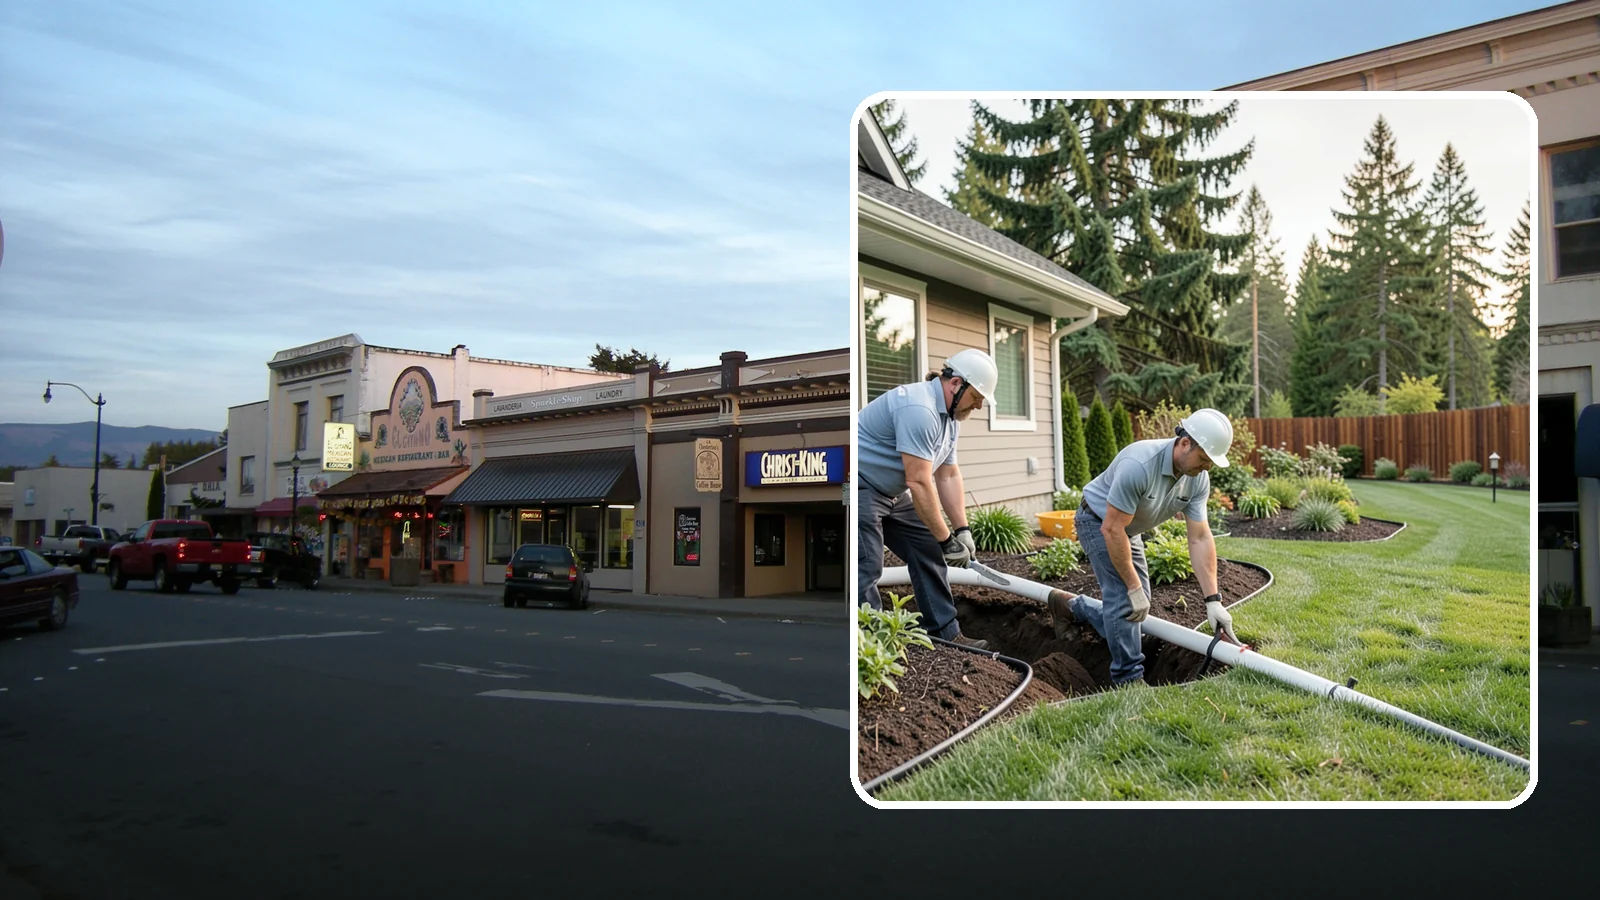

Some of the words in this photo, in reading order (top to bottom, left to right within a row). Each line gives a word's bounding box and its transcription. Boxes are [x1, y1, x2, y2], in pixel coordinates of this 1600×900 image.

[595, 389, 624, 400] LAUNDRY
[530, 397, 561, 409] Sparkle
[561, 393, 583, 406] Shop
[493, 402, 523, 413] LAVANDERIA
[373, 455, 396, 464] MEXICAN
[397, 451, 433, 462] RESTAURANT
[438, 450, 450, 459] BAR
